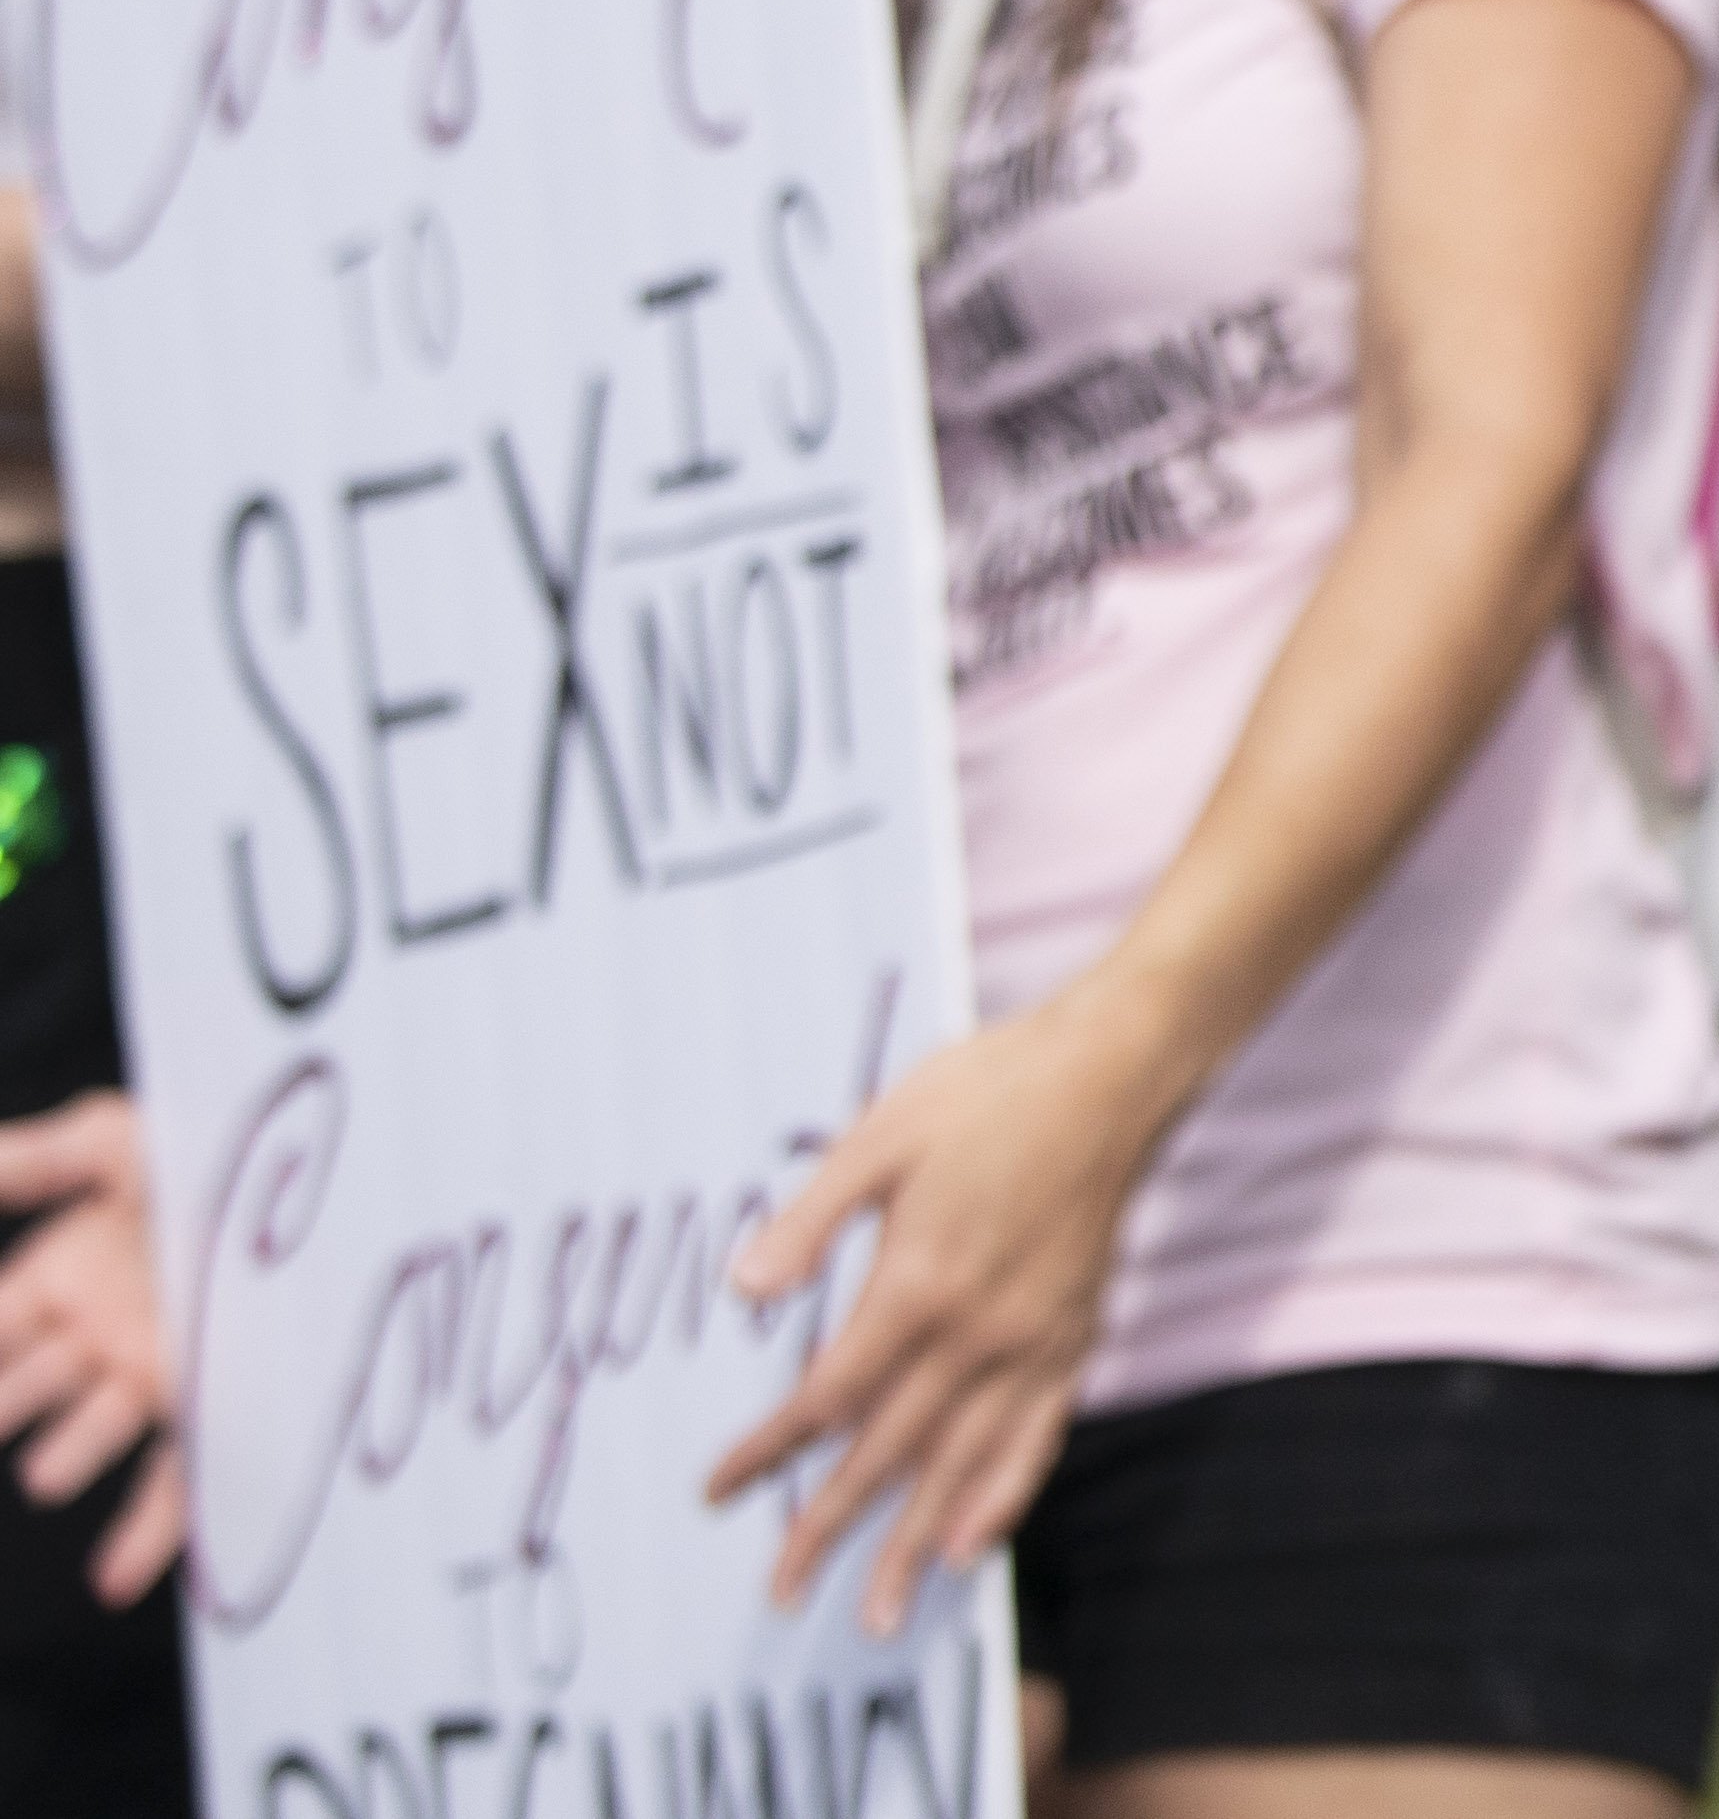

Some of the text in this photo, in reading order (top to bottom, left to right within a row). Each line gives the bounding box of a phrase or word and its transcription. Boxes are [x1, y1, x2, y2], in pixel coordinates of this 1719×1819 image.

[328, 197, 466, 387] TO
[634, 180, 842, 500] IS
[215, 370, 648, 1017] SEX
[636, 532, 866, 838] NOT
